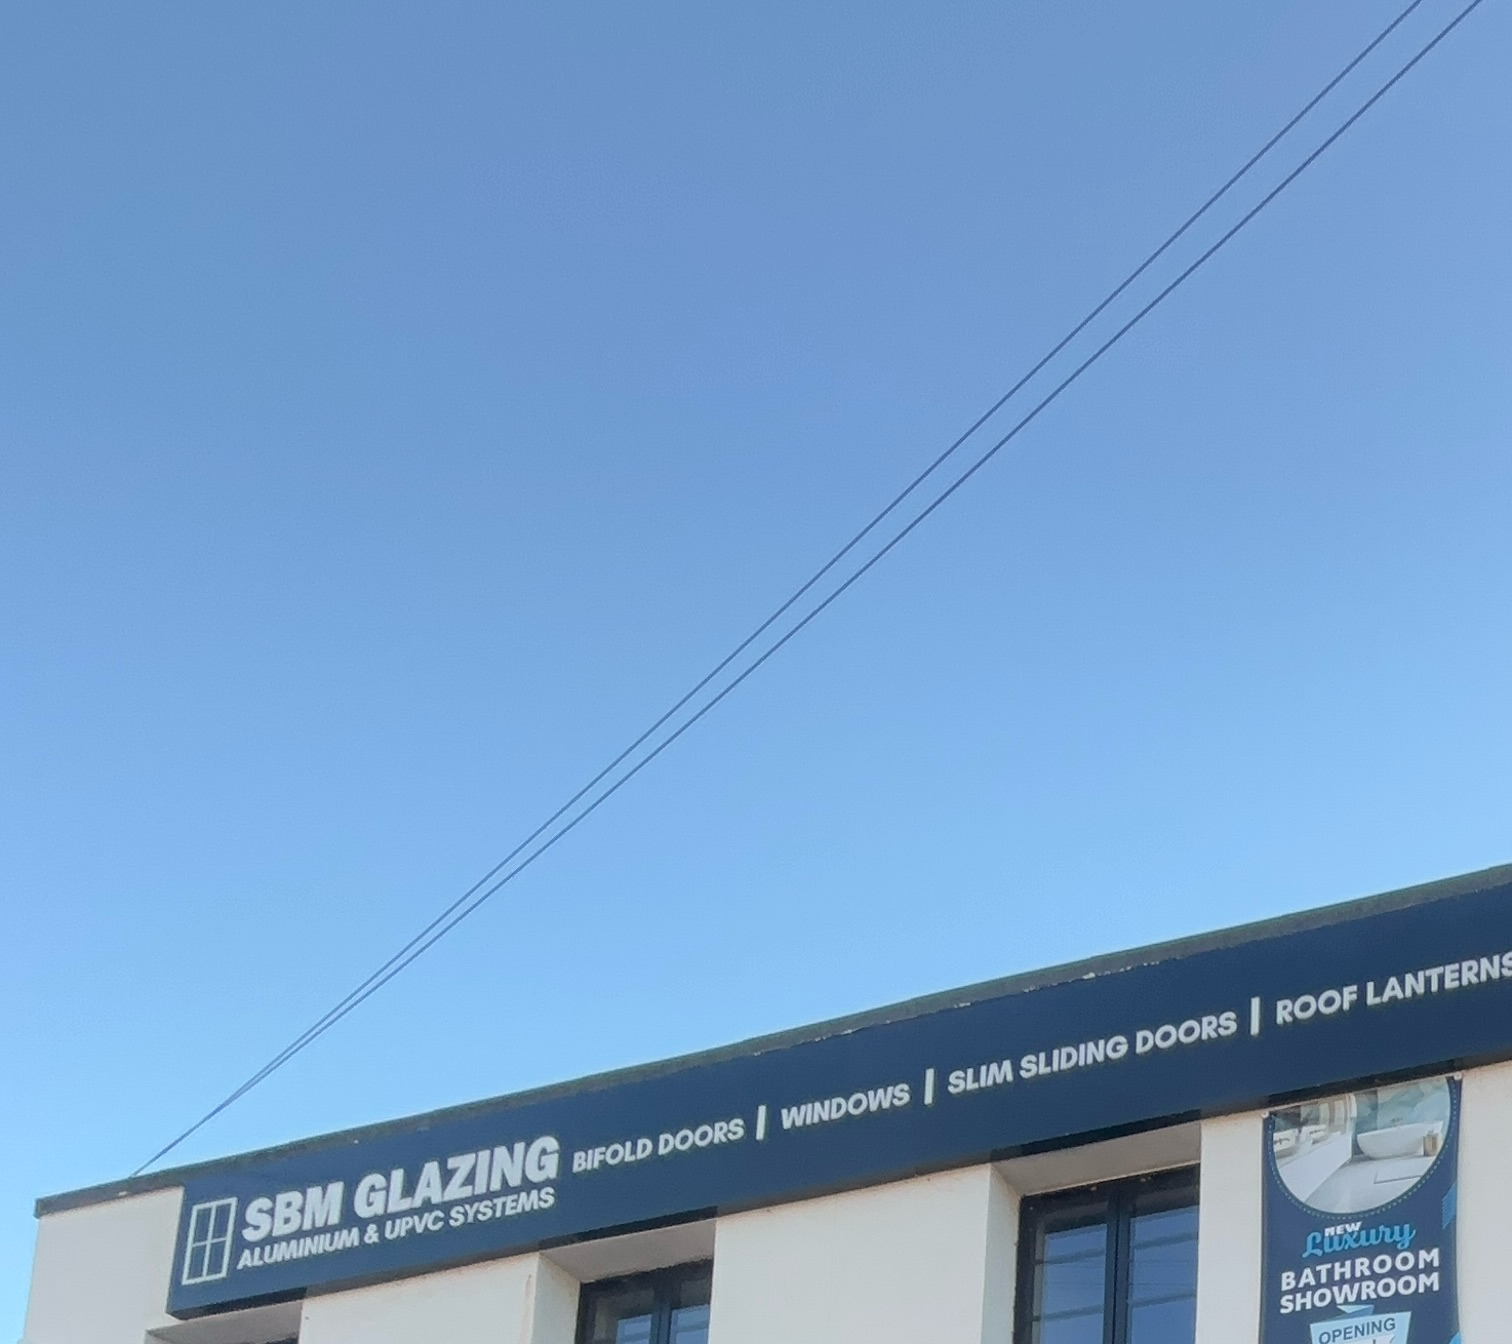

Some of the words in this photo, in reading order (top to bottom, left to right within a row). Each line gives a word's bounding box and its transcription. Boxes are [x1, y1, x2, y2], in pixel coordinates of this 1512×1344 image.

[1276, 985, 1358, 1025] ROOF
[947, 1060, 1014, 1094] SLIM
[1019, 1035, 1128, 1079] SLIDING
[1135, 1012, 1238, 1054] DOORS
[781, 1083, 911, 1130] WINDOWS
[572, 1139, 653, 1173] BIFOLD
[658, 1118, 745, 1156] DOORS
[241, 1181, 345, 1243] SBM
[353, 1135, 560, 1219] GLAZING
[236, 1226, 360, 1270] ALUMINIUM
[363, 1223, 380, 1244] &
[384, 1211, 445, 1240] UPVC
[449, 1186, 556, 1227] SYSTEMS
[1302, 1223, 1416, 1259] Luxury
[1324, 1221, 1362, 1237] NEW
[1280, 1247, 1440, 1291] BATHROOM
[1279, 1271, 1440, 1314] SHOWROOM
[1318, 1317, 1396, 1344] OPENING
